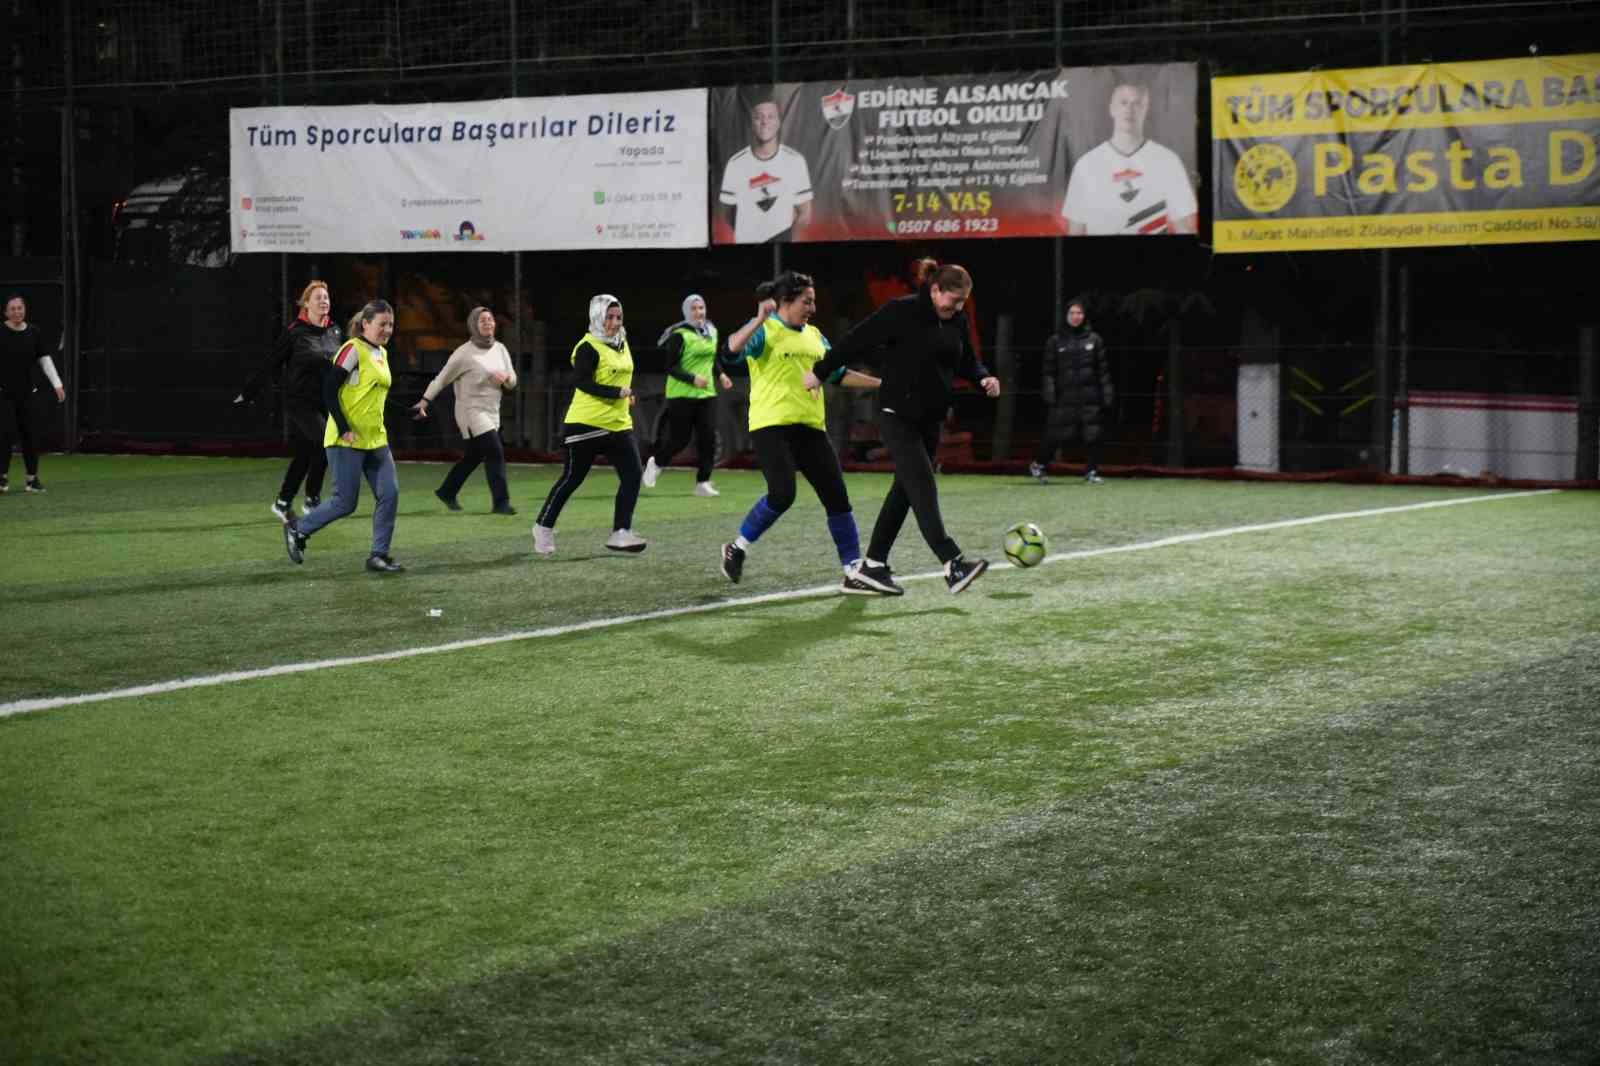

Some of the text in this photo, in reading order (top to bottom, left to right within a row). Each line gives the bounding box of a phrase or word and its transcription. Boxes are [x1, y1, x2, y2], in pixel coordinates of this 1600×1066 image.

[857, 80, 1069, 108] EDİRNE ALSANCAK
[1304, 79, 1531, 119] SPORCULARA
[878, 103, 1044, 129] FUTBOL OKULU
[247, 109, 676, 152] Tüm Sporculara Başarılar Dileriz
[1313, 141, 1523, 197] Pasta
[893, 190, 993, 216] 7-14 YAŞ
[899, 220, 930, 234] 0507
[964, 218, 999, 232] 1923
[1242, 227, 1282, 241] Murat
[1288, 224, 1353, 240] Mahallesi
[1482, 219, 1543, 233] Caddesi
